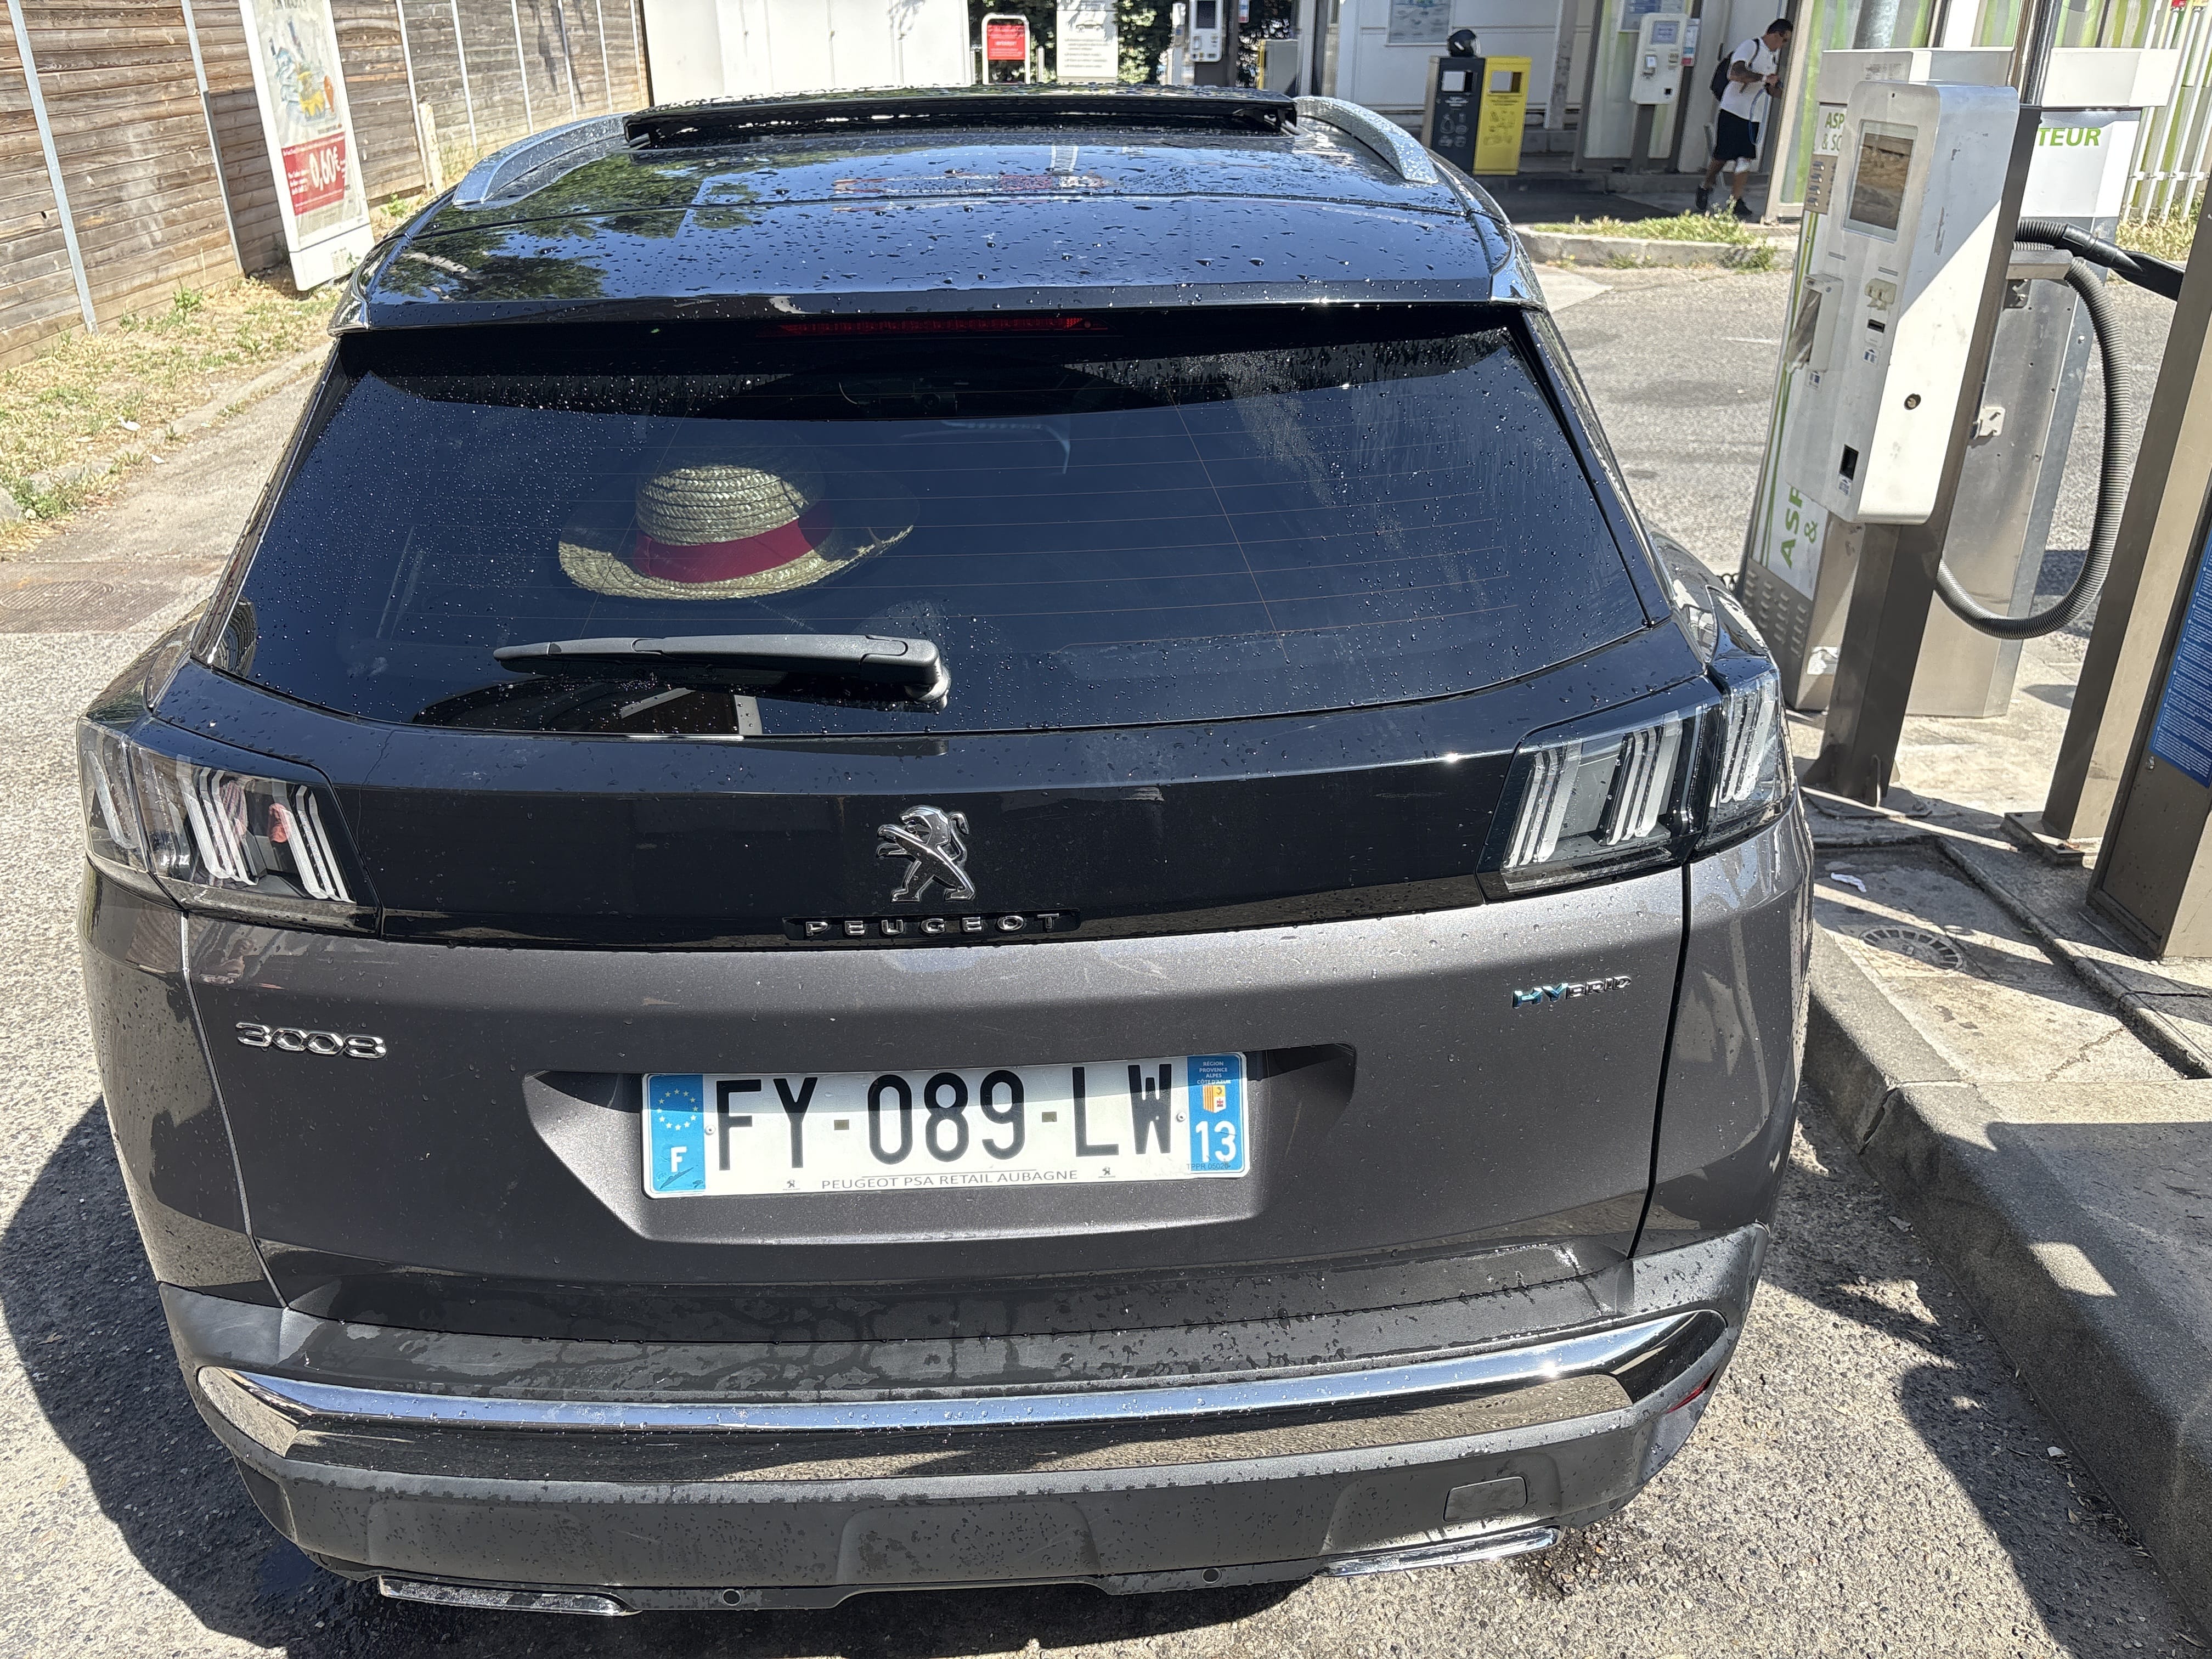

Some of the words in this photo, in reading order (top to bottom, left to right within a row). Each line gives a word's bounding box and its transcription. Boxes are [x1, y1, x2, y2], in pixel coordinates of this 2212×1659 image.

[1821, 133, 1829, 150] &
[1804, 521, 1817, 544] &
[805, 913, 1060, 936] PEUGEOT
[1513, 976, 1632, 1009] HYBRID
[235, 1022, 386, 1058] 3008
[1196, 1121, 1236, 1163] 13
[670, 1146, 687, 1172] F
[822, 1178, 899, 1189] PEUGEOT
[904, 1176, 934, 1186] PSA
[939, 1173, 991, 1185] RETAIL
[997, 1170, 1078, 1183] AUBAGNE
